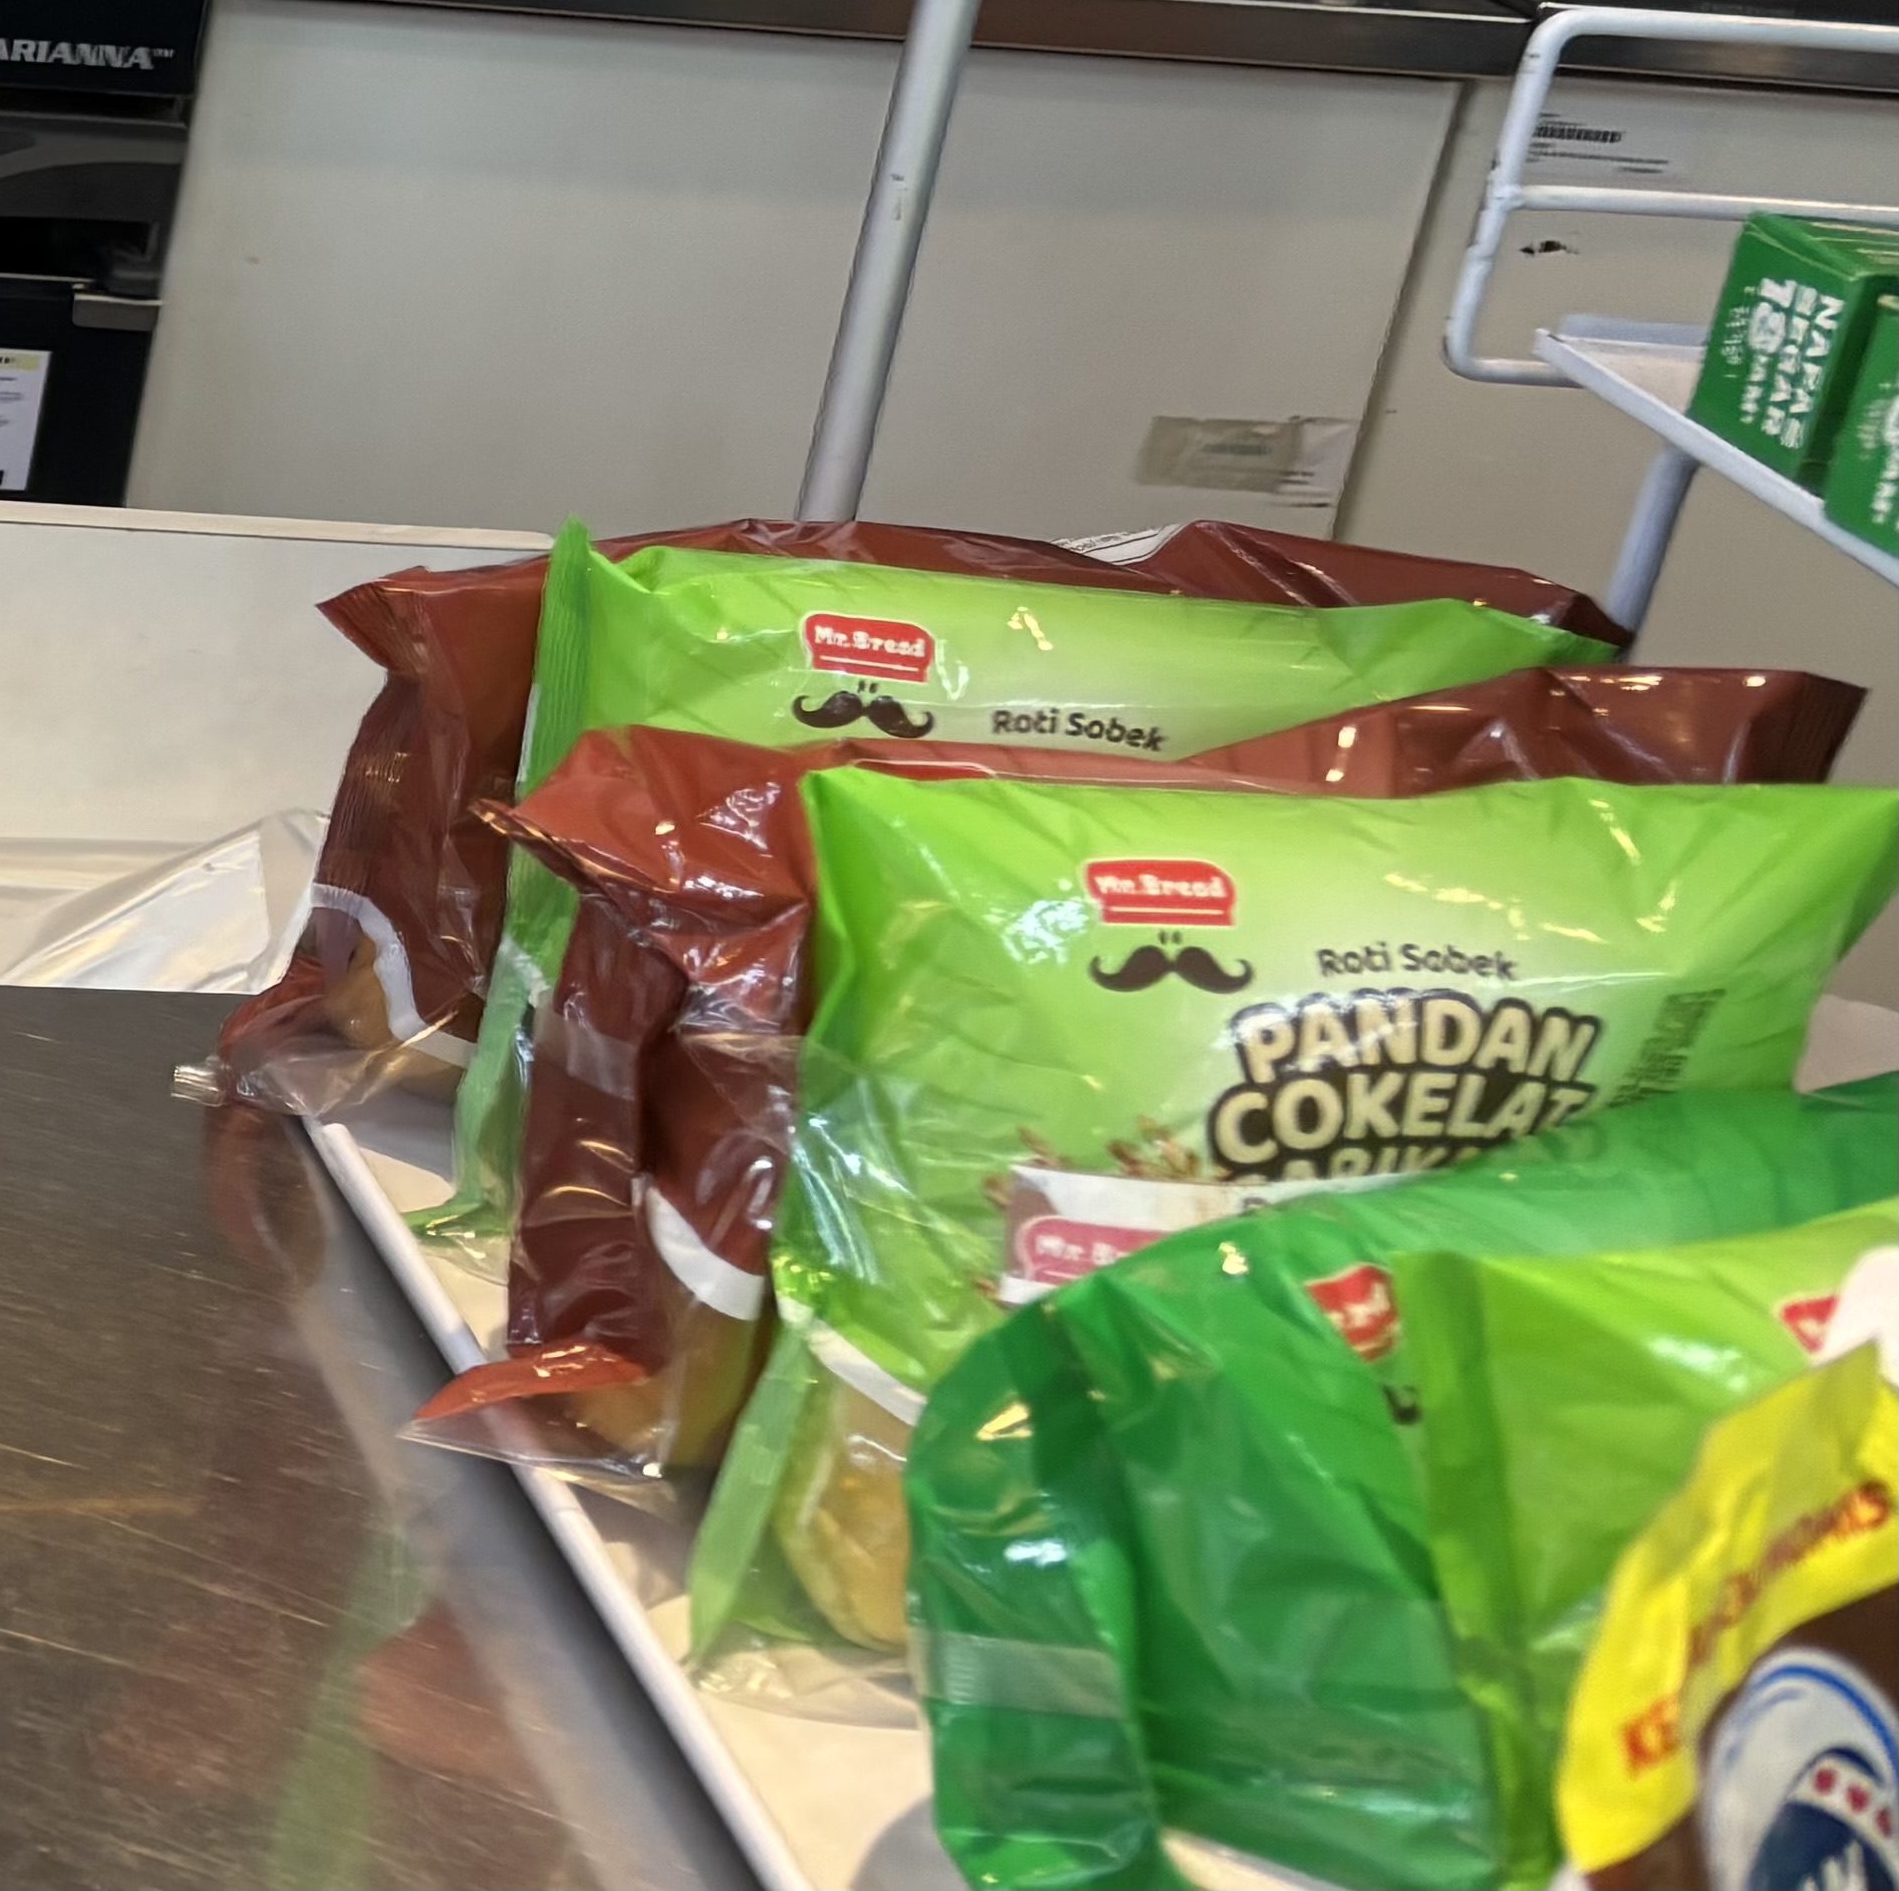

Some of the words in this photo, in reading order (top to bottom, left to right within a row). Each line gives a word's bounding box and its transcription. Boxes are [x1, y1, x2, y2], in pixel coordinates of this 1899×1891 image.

[992, 709, 1057, 736] Roti
[1066, 711, 1168, 752] Sobek
[1317, 941, 1389, 977] Roti
[1403, 944, 1519, 982] Sobek
[1232, 992, 1598, 1085] PANDAN
[1212, 1072, 1590, 1166] COKELAT
